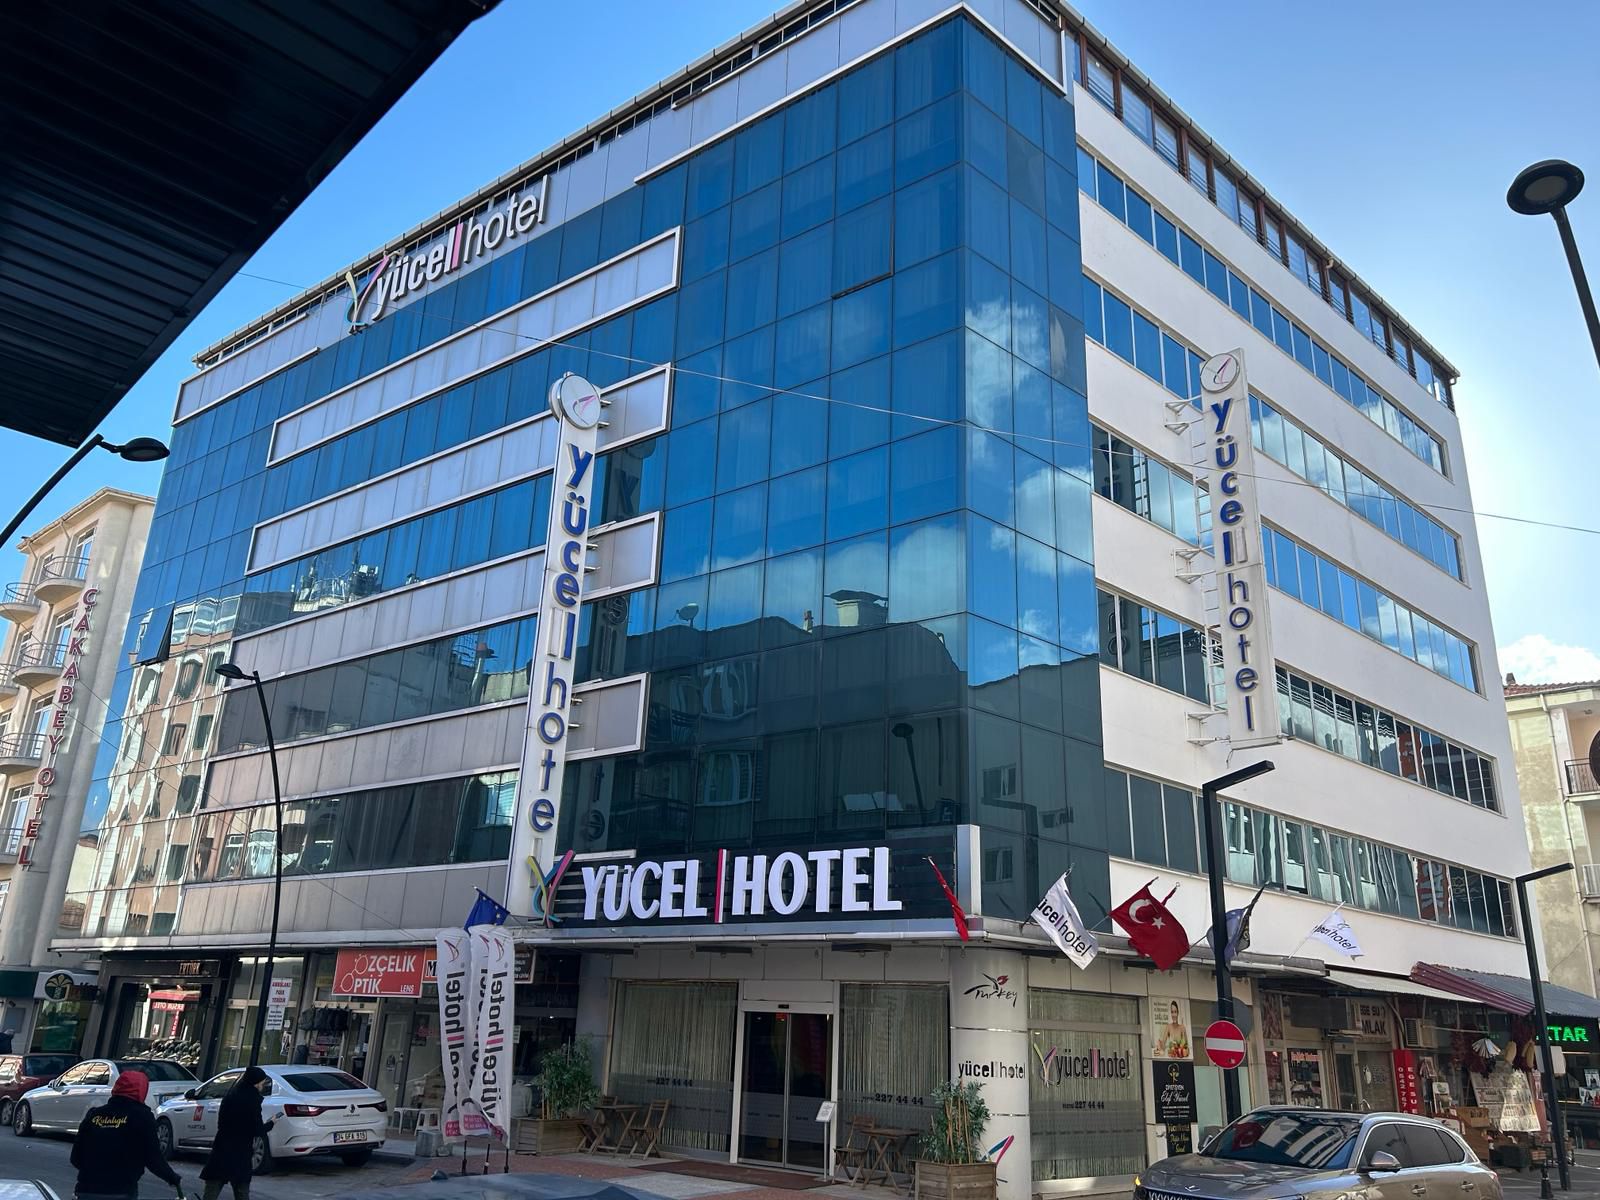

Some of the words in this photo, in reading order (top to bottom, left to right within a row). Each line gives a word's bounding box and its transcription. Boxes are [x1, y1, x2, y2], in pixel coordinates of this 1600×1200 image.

[464, 174, 551, 264] hotel
[554, 442, 594, 661] yücel
[1211, 398, 1243, 567] yücel
[1229, 572, 1259, 731] hotel
[48, 588, 98, 754] ÇAKABEY
[529, 661, 567, 888] hotel
[19, 767, 56, 866] OTEL
[582, 859, 708, 921] YÜCEL
[732, 846, 903, 916] HOTEL
[1058, 920, 1093, 957] hotel
[875, 1093, 893, 1103] 227
[896, 1095, 908, 1104] 44
[911, 1096, 923, 1105] 44
[958, 1061, 994, 1078] yücel
[1000, 1062, 1026, 1079] hotel
[1056, 1048, 1093, 1085] yücel
[1098, 1049, 1131, 1079] hotel
[1075, 1101, 1087, 1109] 227
[1088, 1101, 1096, 1109] 44
[1097, 1101, 1105, 1109] 44
